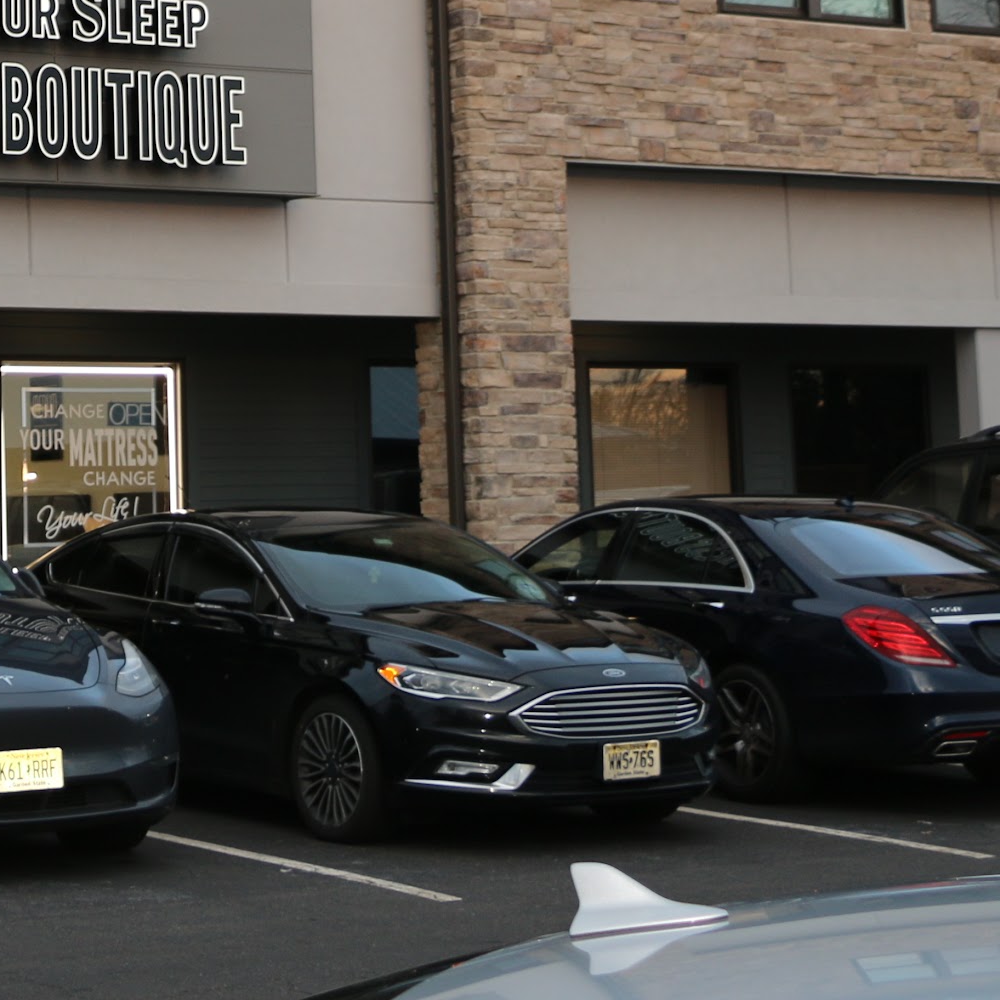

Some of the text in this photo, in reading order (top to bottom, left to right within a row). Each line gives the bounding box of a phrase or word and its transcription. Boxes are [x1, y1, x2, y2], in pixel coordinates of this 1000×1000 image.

[0, 61, 247, 168] BOUTIQUE
[31, 404, 105, 419] CHANGE
[109, 403, 167, 426] OPEN
[19, 428, 158, 467] YOUR MATTRESS
[83, 471, 156, 486] CHANGE
[37, 505, 93, 539] Your
